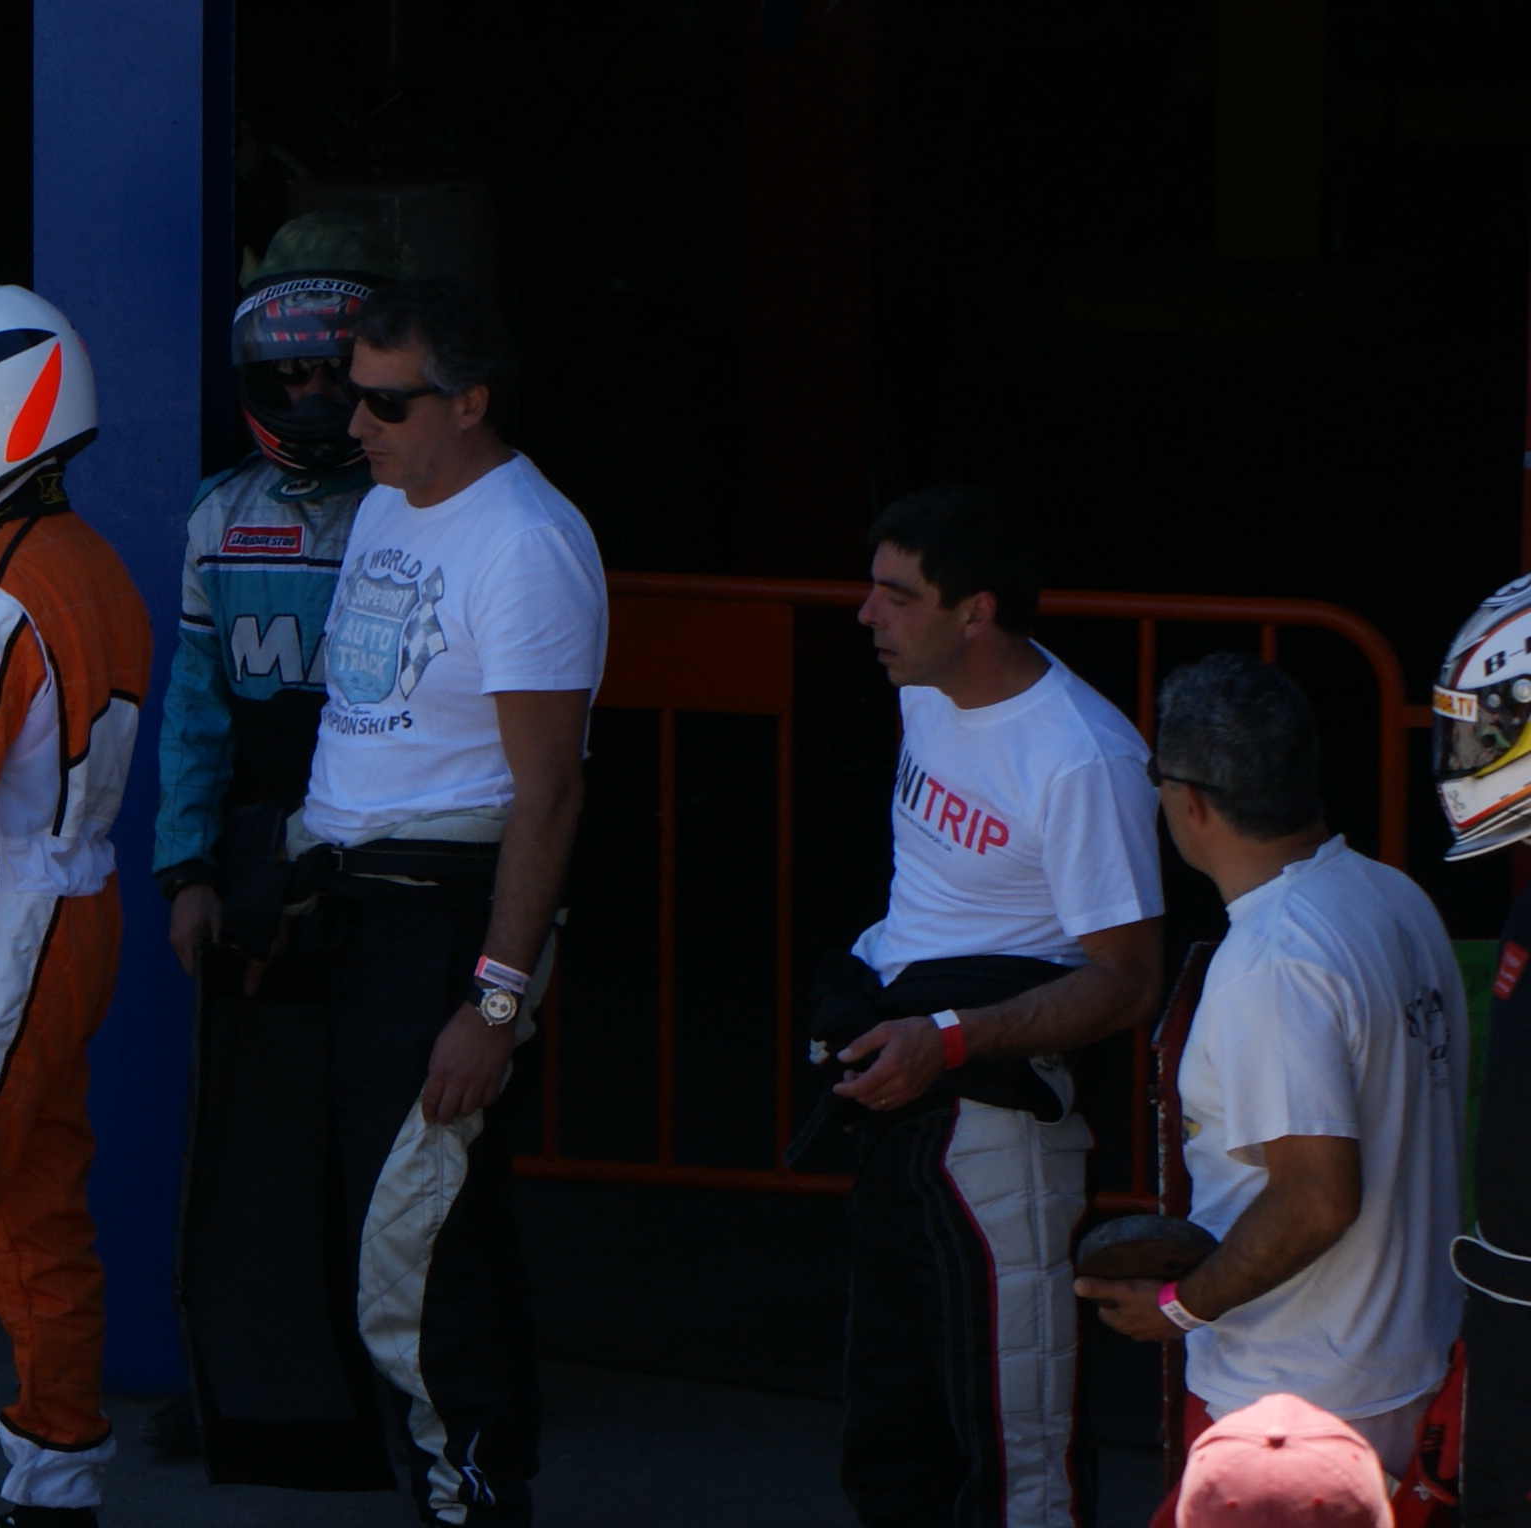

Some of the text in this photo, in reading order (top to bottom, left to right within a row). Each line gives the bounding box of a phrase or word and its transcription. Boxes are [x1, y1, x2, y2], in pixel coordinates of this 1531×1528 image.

[369, 549, 423, 579] WORLD
[340, 618, 395, 653] AUTO
[338, 645, 388, 683] TRACK
